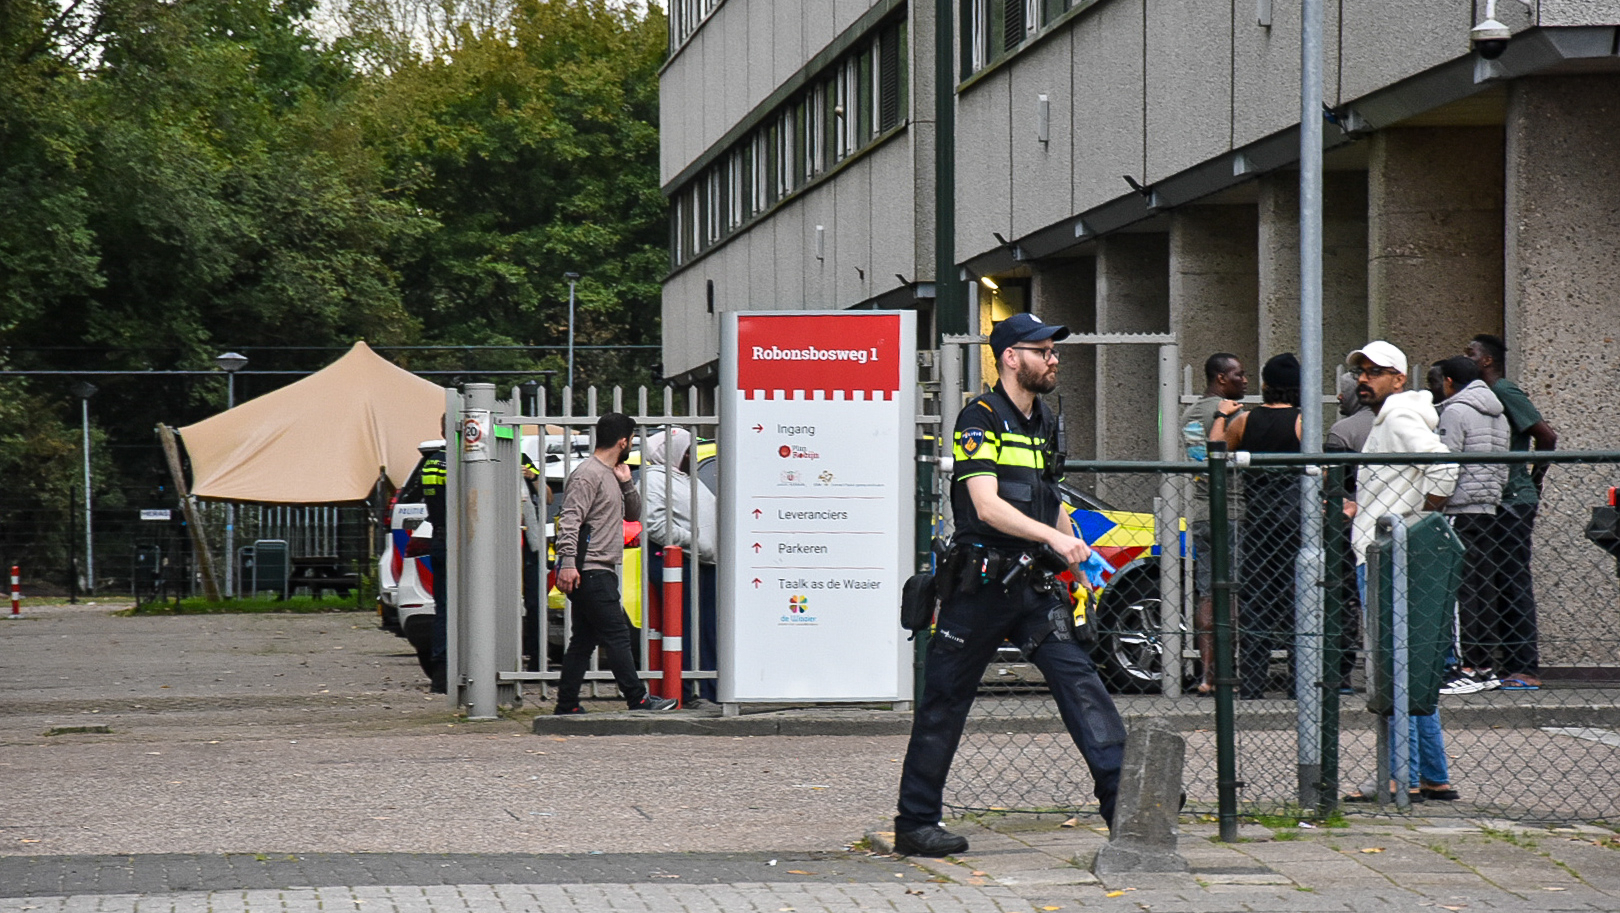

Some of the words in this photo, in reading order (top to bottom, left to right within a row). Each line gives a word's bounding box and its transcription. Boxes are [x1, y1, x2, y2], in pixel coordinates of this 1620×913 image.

[752, 346, 868, 363] Robonsbosweg
[870, 347, 878, 361] 1
[465, 426, 477, 436] 20
[777, 424, 815, 436] Ingang
[778, 509, 848, 520] Leveranciers
[778, 543, 828, 554] Parkeren
[826, 578, 840, 589] de
[843, 579, 881, 589] Waaier
